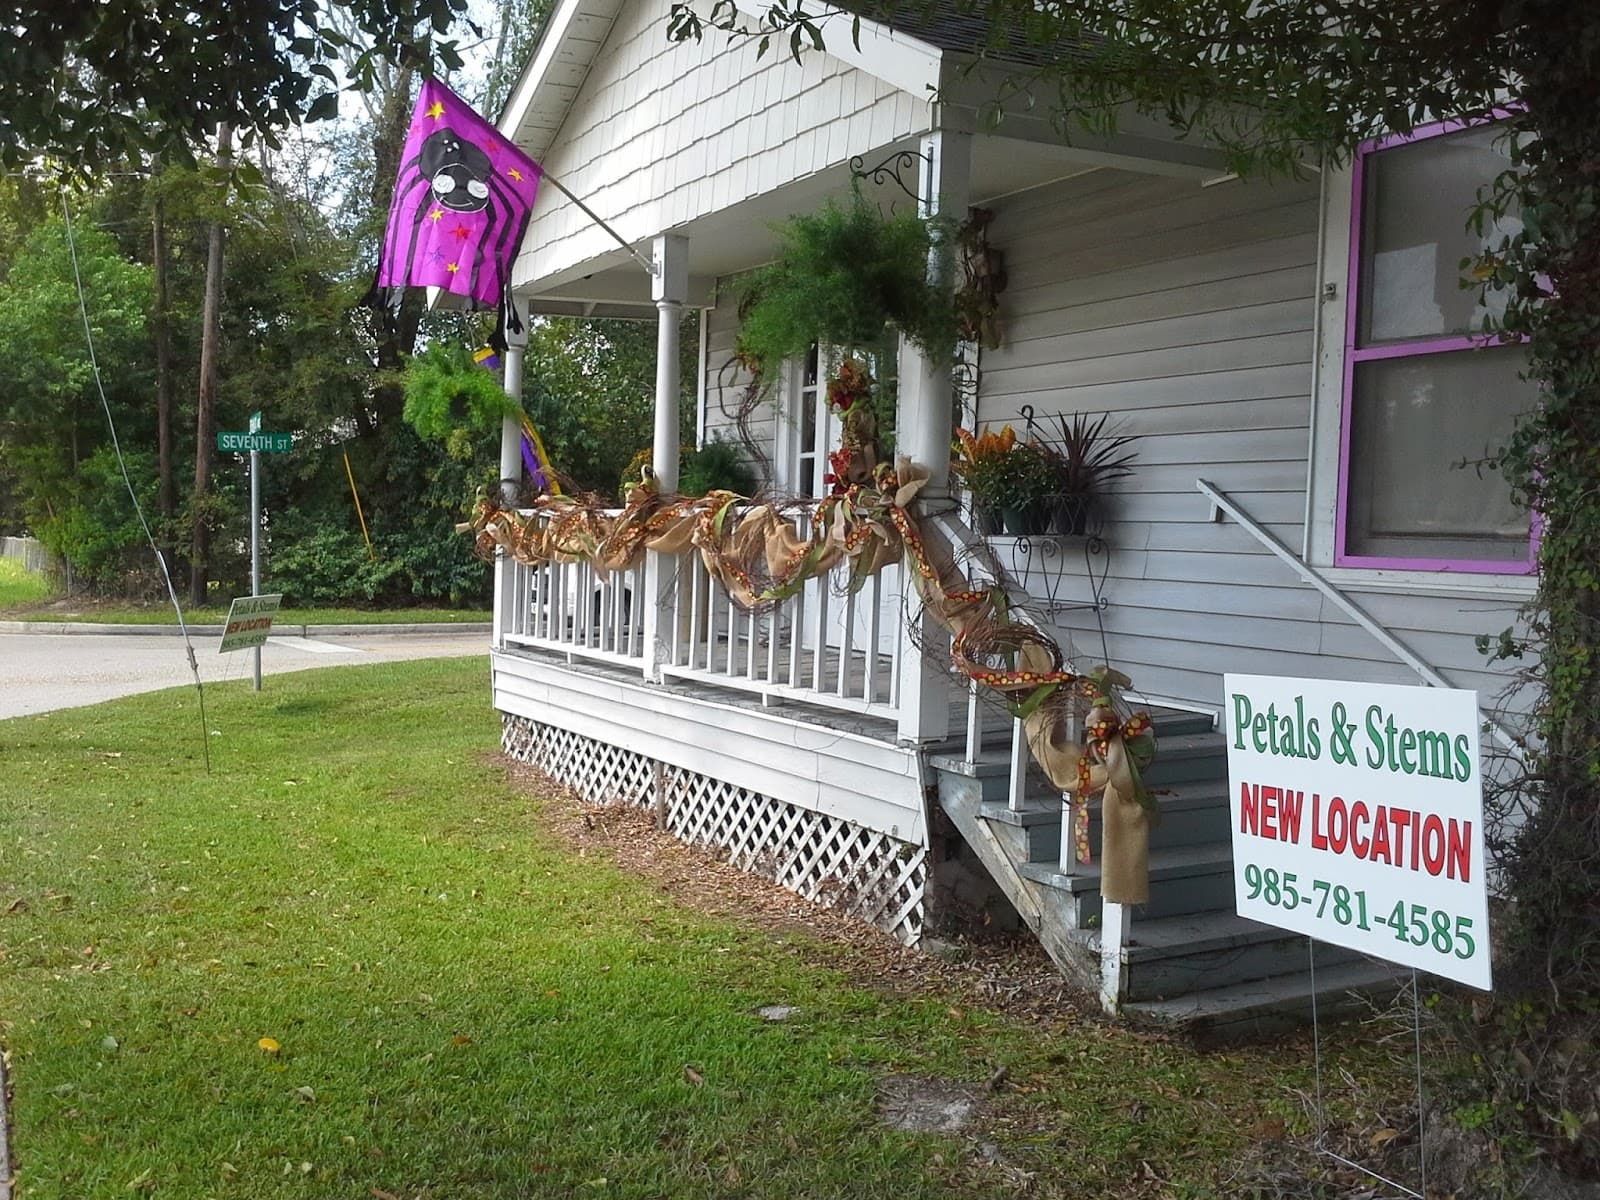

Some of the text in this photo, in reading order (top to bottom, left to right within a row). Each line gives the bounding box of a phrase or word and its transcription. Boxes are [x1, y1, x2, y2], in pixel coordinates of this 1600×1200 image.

[223, 435, 288, 449] SEVENTH ST
[1231, 693, 1472, 783] Petals & Stems
[1240, 782, 1473, 883] NEW LOCATION
[1244, 863, 1476, 960] 985-781-4585
